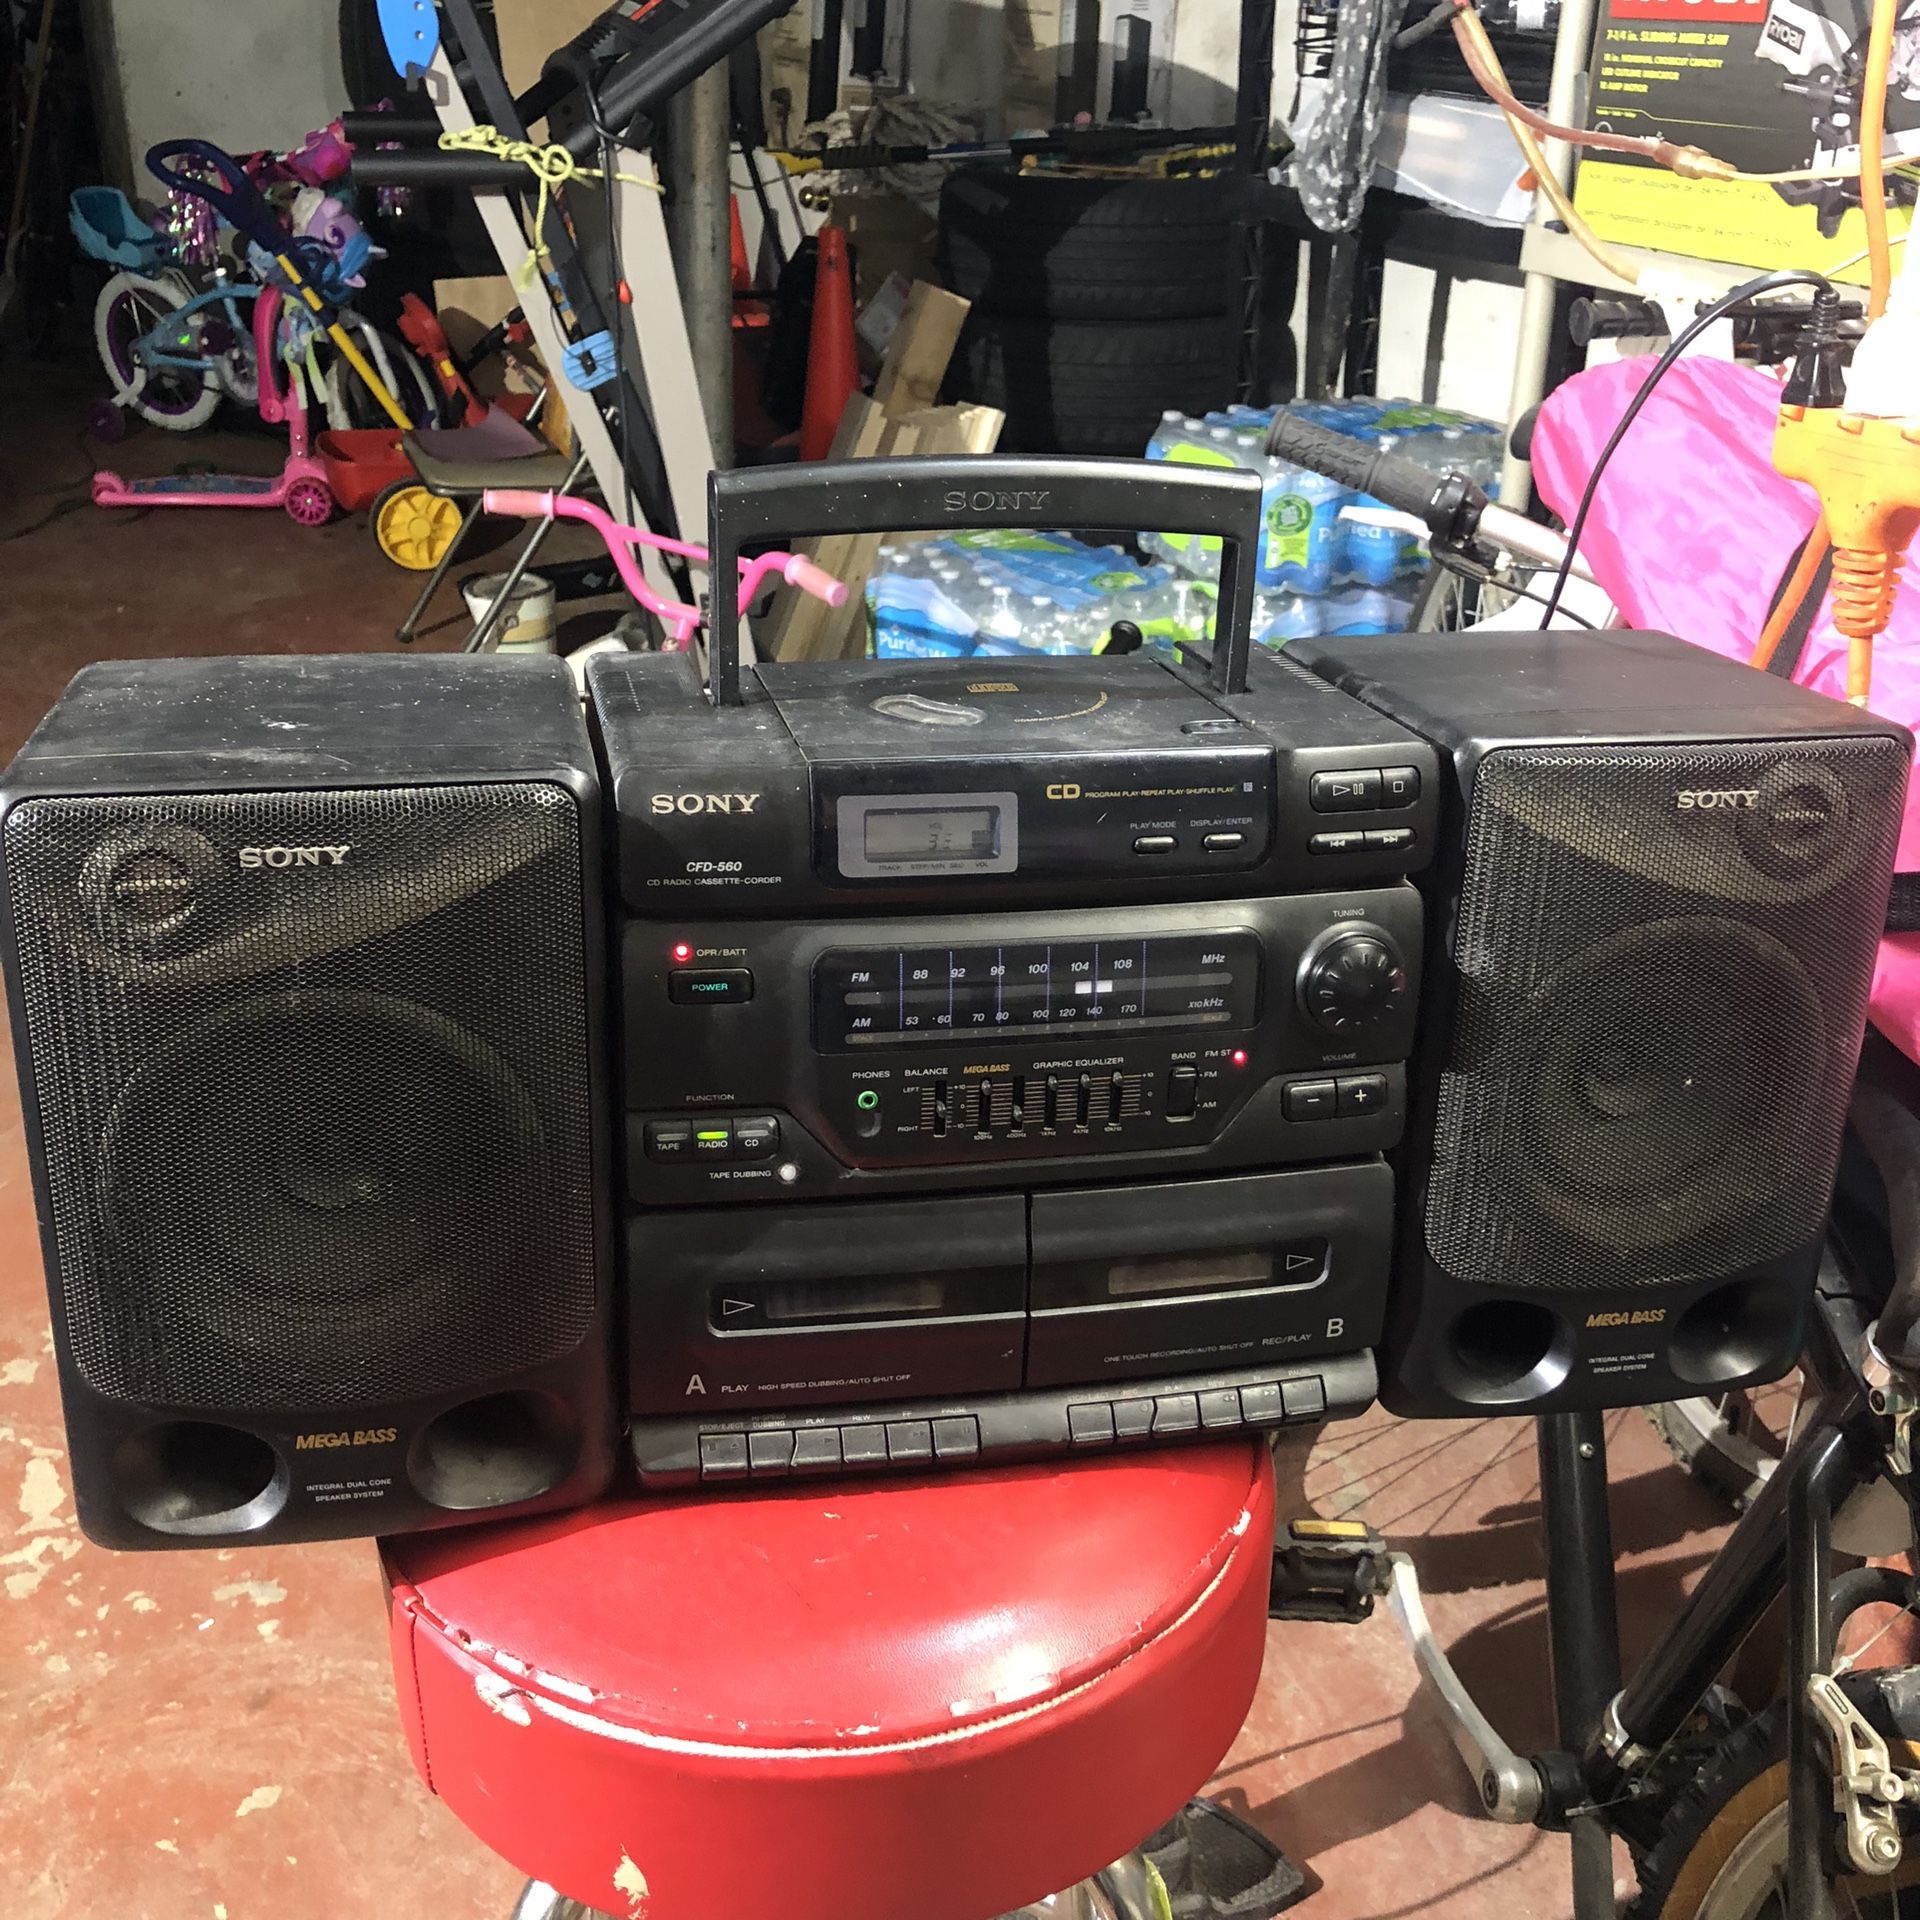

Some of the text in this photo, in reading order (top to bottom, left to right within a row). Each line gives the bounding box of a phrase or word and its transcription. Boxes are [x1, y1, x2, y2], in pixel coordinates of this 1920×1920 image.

[1768, 20, 1803, 50] RYOBI
[943, 490, 1050, 512] SONY
[1046, 783, 1081, 800] CD
[1084, 791, 1121, 799] PROGRAM
[1216, 786, 1234, 794] PLAY
[651, 793, 760, 815] SONY
[1677, 790, 1760, 810] SONY
[1129, 820, 1177, 830] PLAY MODE
[1190, 817, 1253, 828] DISPLAY/ENTER
[239, 845, 351, 869] SONY
[686, 861, 743, 873] CFD-560
[647, 876, 782, 887] CD RADIO CASSETTE-CORDER
[1332, 907, 1365, 918] TUNING
[696, 948, 748, 958] OPR/BATT
[851, 954, 1226, 983] FM 88 92 96 100 104 108 MHz
[691, 983, 729, 992] POWER
[852, 1017, 872, 1028] AM
[905, 1016, 919, 1026] 53
[937, 1014, 951, 1024] 60
[972, 1012, 986, 1022] 70
[995, 1011, 1010, 1021] 80
[1032, 1009, 1050, 1019] 100
[1059, 1008, 1077, 1018] 120
[1086, 1006, 1103, 1016] 140
[1120, 1004, 1137, 1014] 170
[1171, 1051, 1197, 1060] BAND
[1204, 1049, 1232, 1058] FM ST
[1322, 1053, 1357, 1062] VOLUME
[1032, 1056, 1125, 1070] GRAPHIC EQUALIZER
[852, 1070, 891, 1079] PHONES
[904, 1067, 949, 1077] BALANCE
[963, 1063, 1011, 1075] MEGA BASS
[902, 1086, 920, 1094] LEFT
[686, 1093, 735, 1102] FUNCTION
[1202, 1101, 1217, 1109] AM
[897, 1125, 918, 1133] RIGHT
[656, 1142, 680, 1151] TAPE
[698, 1140, 728, 1149] RADIO
[744, 1138, 759, 1147] CD
[709, 1169, 772, 1180] TAPE DUBBING
[1585, 1308, 1667, 1328] MEGA BASS
[1122, 1353, 1149, 1361] TOUCH
[1262, 1333, 1312, 1346] REC/PLAY
[1326, 1318, 1344, 1338] B
[1588, 1355, 1619, 1364] INTEGRAL
[1637, 1352, 1655, 1360] CONE
[1593, 1363, 1647, 1374] SPEAKER SYSTEM
[685, 1374, 707, 1395] A
[721, 1384, 749, 1393] PLAY
[780, 1382, 807, 1390] SPEED
[808, 1377, 871, 1388] DUBBING/AUTO
[873, 1375, 894, 1383] SHUT
[895, 1373, 911, 1381] OFF
[752, 1420, 786, 1429] DUBBING
[805, 1417, 826, 1425] PLAY
[295, 1427, 398, 1450] MEGA BASS
[306, 1478, 392, 1492] INTEGRAL DUAL CONE
[315, 1490, 384, 1502] SPEAKER SYSTEM
